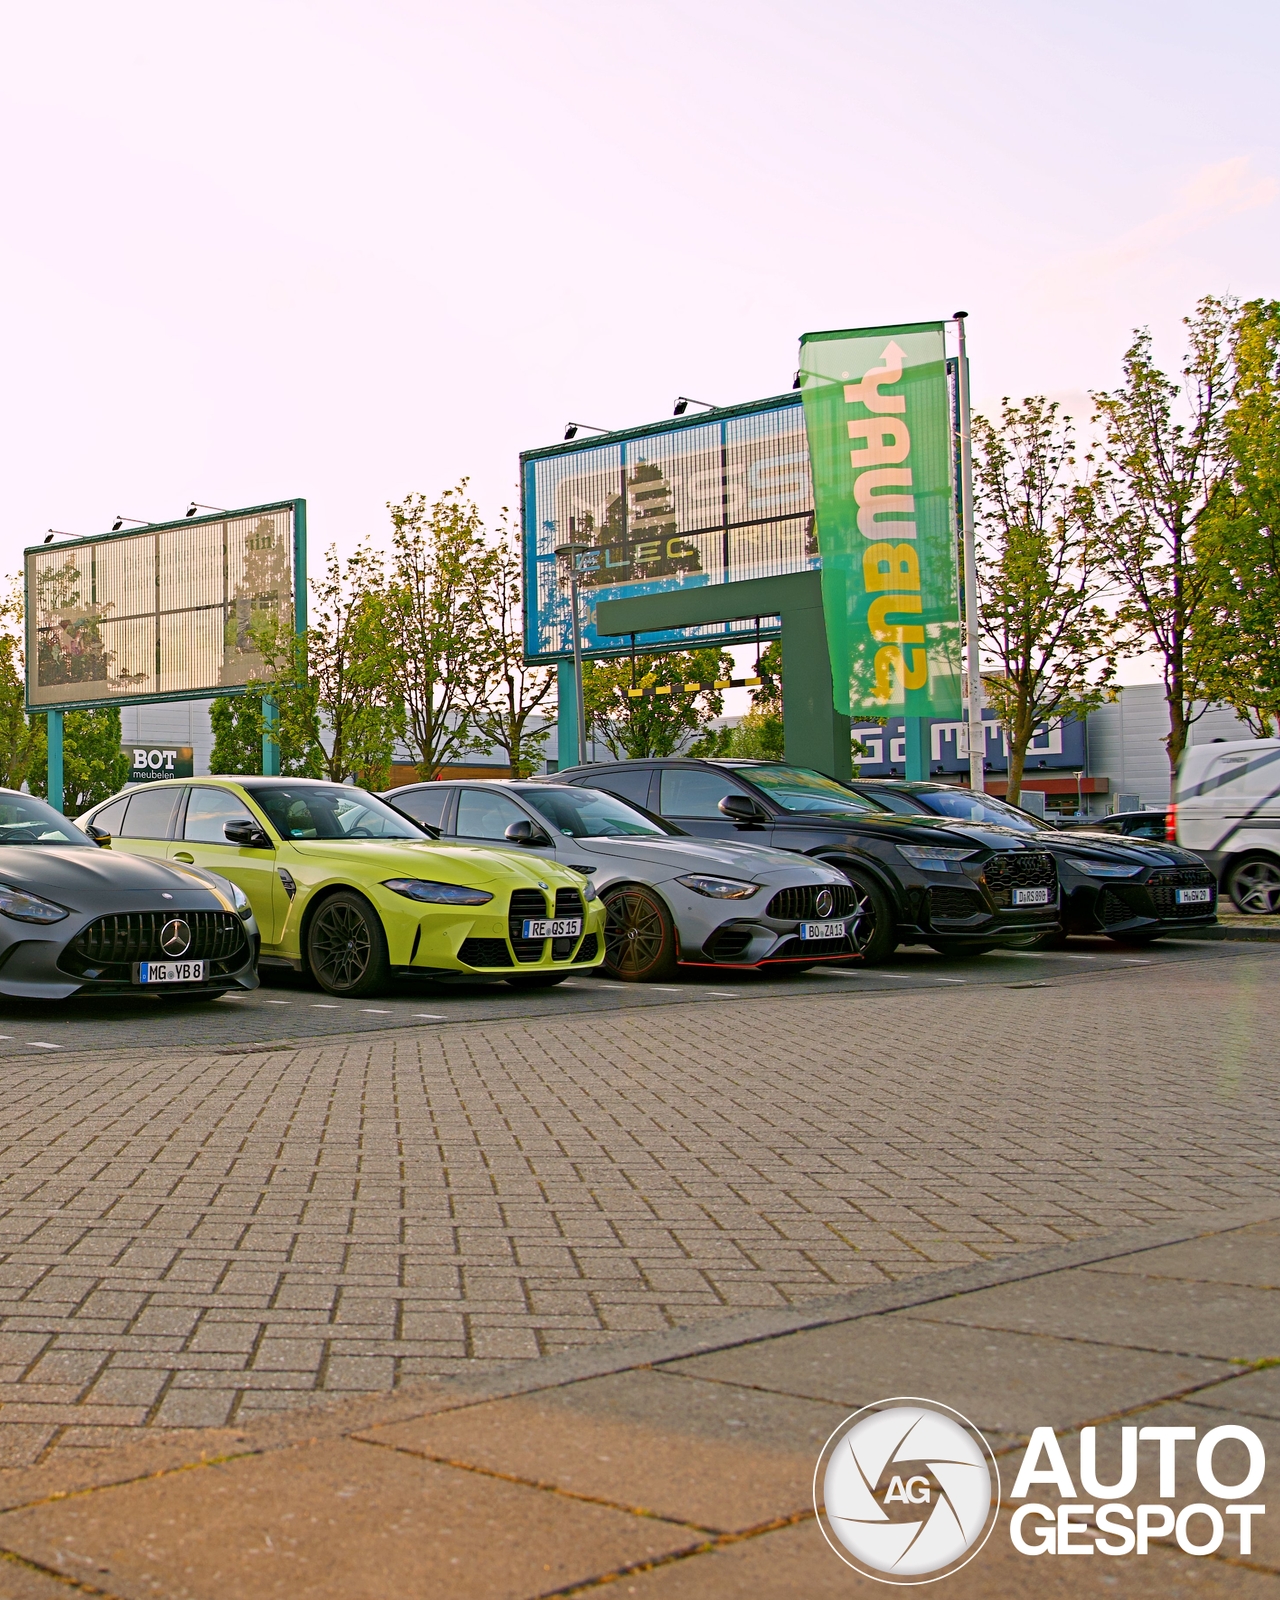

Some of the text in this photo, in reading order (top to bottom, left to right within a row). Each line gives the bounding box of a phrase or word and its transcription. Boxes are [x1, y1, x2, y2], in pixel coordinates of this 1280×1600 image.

[132, 749, 177, 770] BOT
[133, 770, 175, 780] meubelen
[532, 921, 577, 936] RE QS 15
[809, 924, 843, 937] BO ZA 13
[149, 964, 201, 980] MG YB 8
